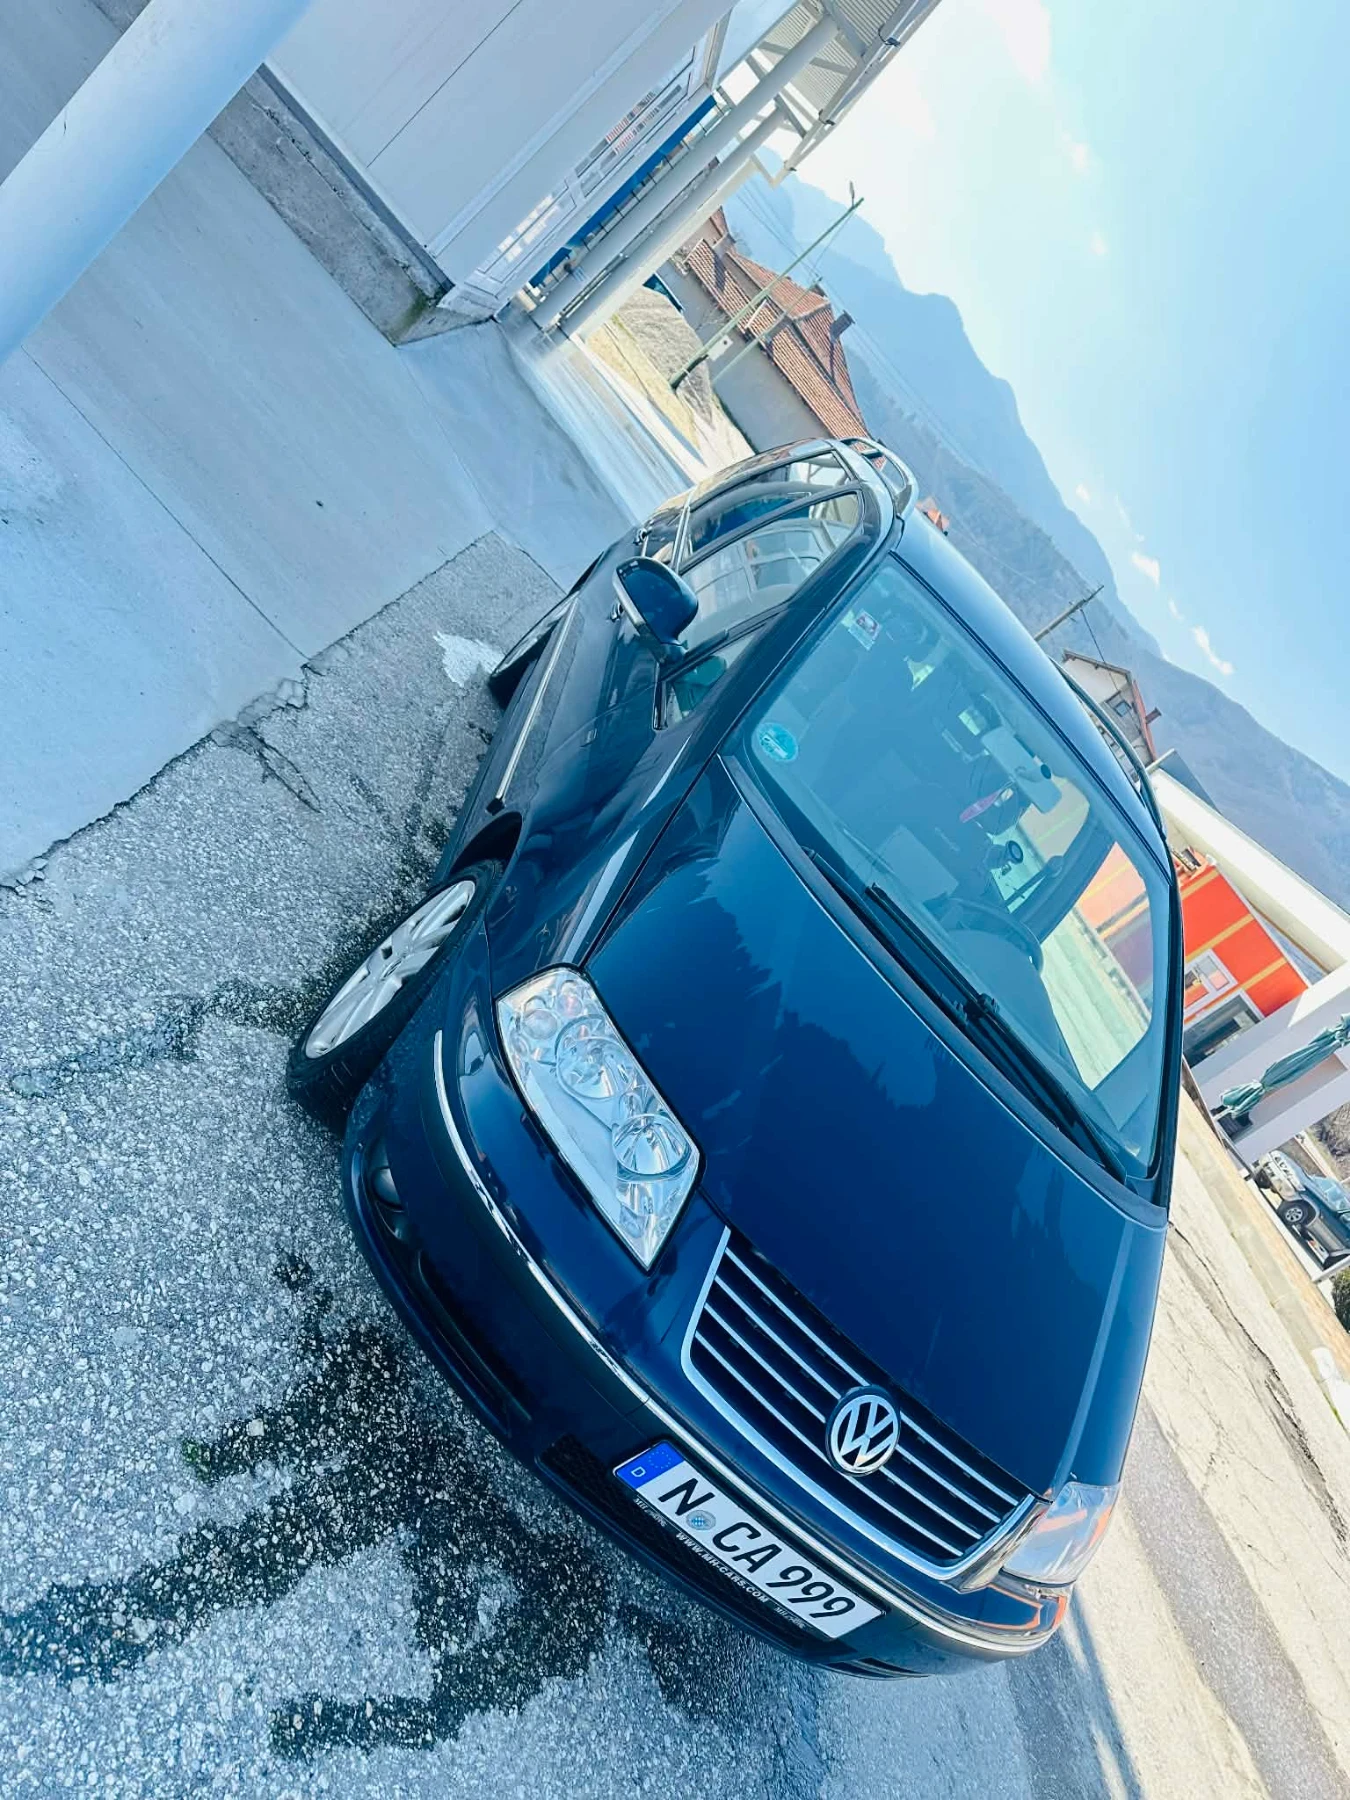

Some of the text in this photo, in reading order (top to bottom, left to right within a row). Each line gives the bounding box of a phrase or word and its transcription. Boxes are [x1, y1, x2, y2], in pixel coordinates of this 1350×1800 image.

[630, 1466, 647, 1478] D
[658, 1478, 715, 1516] N
[712, 1521, 783, 1573] CA
[766, 1566, 856, 1618] 999
[676, 1531, 769, 1603] WWW.MH-CARS.COM
